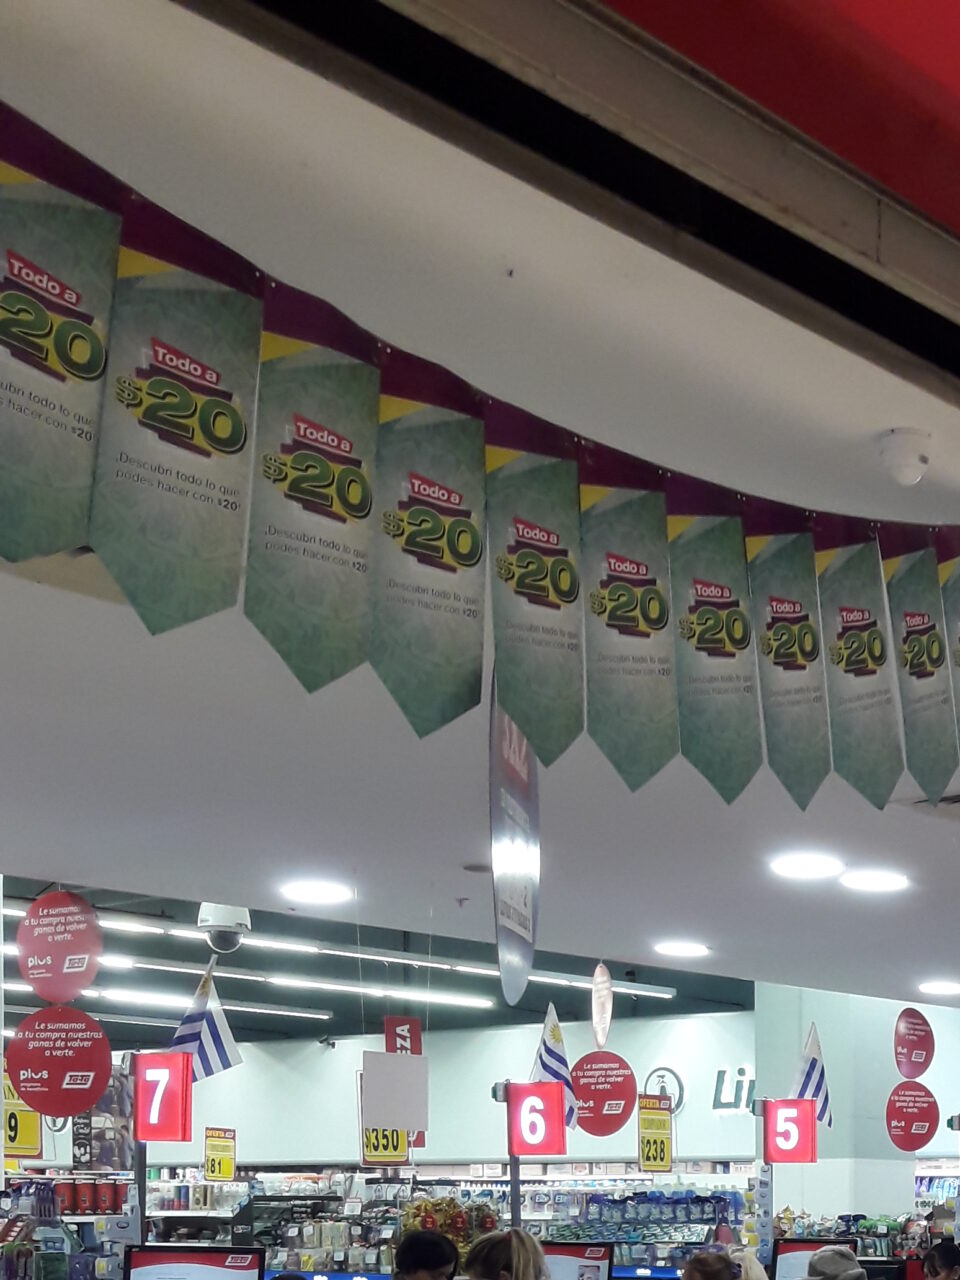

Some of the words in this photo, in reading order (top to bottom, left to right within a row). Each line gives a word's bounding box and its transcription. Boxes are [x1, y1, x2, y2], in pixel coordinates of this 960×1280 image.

[10, 258, 60, 295] Todo
[64, 290, 77, 304] a
[155, 345, 201, 376] Todo
[206, 371, 218, 382] a
[115, 376, 248, 455] $20
[296, 421, 338, 446] Todo
[341, 440, 351, 452] a
[157, 478, 190, 499] hacer
[176, 467, 201, 486] todo
[263, 450, 372, 520] $20
[411, 478, 449, 501] Todo
[451, 493, 460, 505] a
[382, 506, 483, 568] $20
[516, 523, 547, 542] Todo
[550, 533, 558, 545] a
[496, 550, 579, 602] $20
[608, 559, 637, 574] Todo
[639, 565, 647, 575] a
[589, 582, 668, 630] $20
[695, 584, 721, 597] Todo
[771, 601, 793, 613] Todo
[841, 611, 862, 622] Todo
[679, 607, 751, 650] $20
[760, 622, 819, 662] $20
[829, 627, 887, 668] $20
[27, 954, 52, 968] plus
[24, 1030, 33, 1039] tu
[35, 1032, 65, 1041] compra
[67, 1030, 103, 1039] nuestras
[35, 1021, 44, 1030] Le
[47, 1022, 86, 1030] sumamos
[28, 1041, 53, 1050] ganas
[55, 1040, 65, 1048] de
[67, 1040, 92, 1048] volver
[20, 1068, 48, 1081] plus
[145, 1068, 170, 1124] 7
[8, 1111, 18, 1143] 9
[521, 1096, 546, 1145] 6
[775, 1108, 799, 1150] 5
